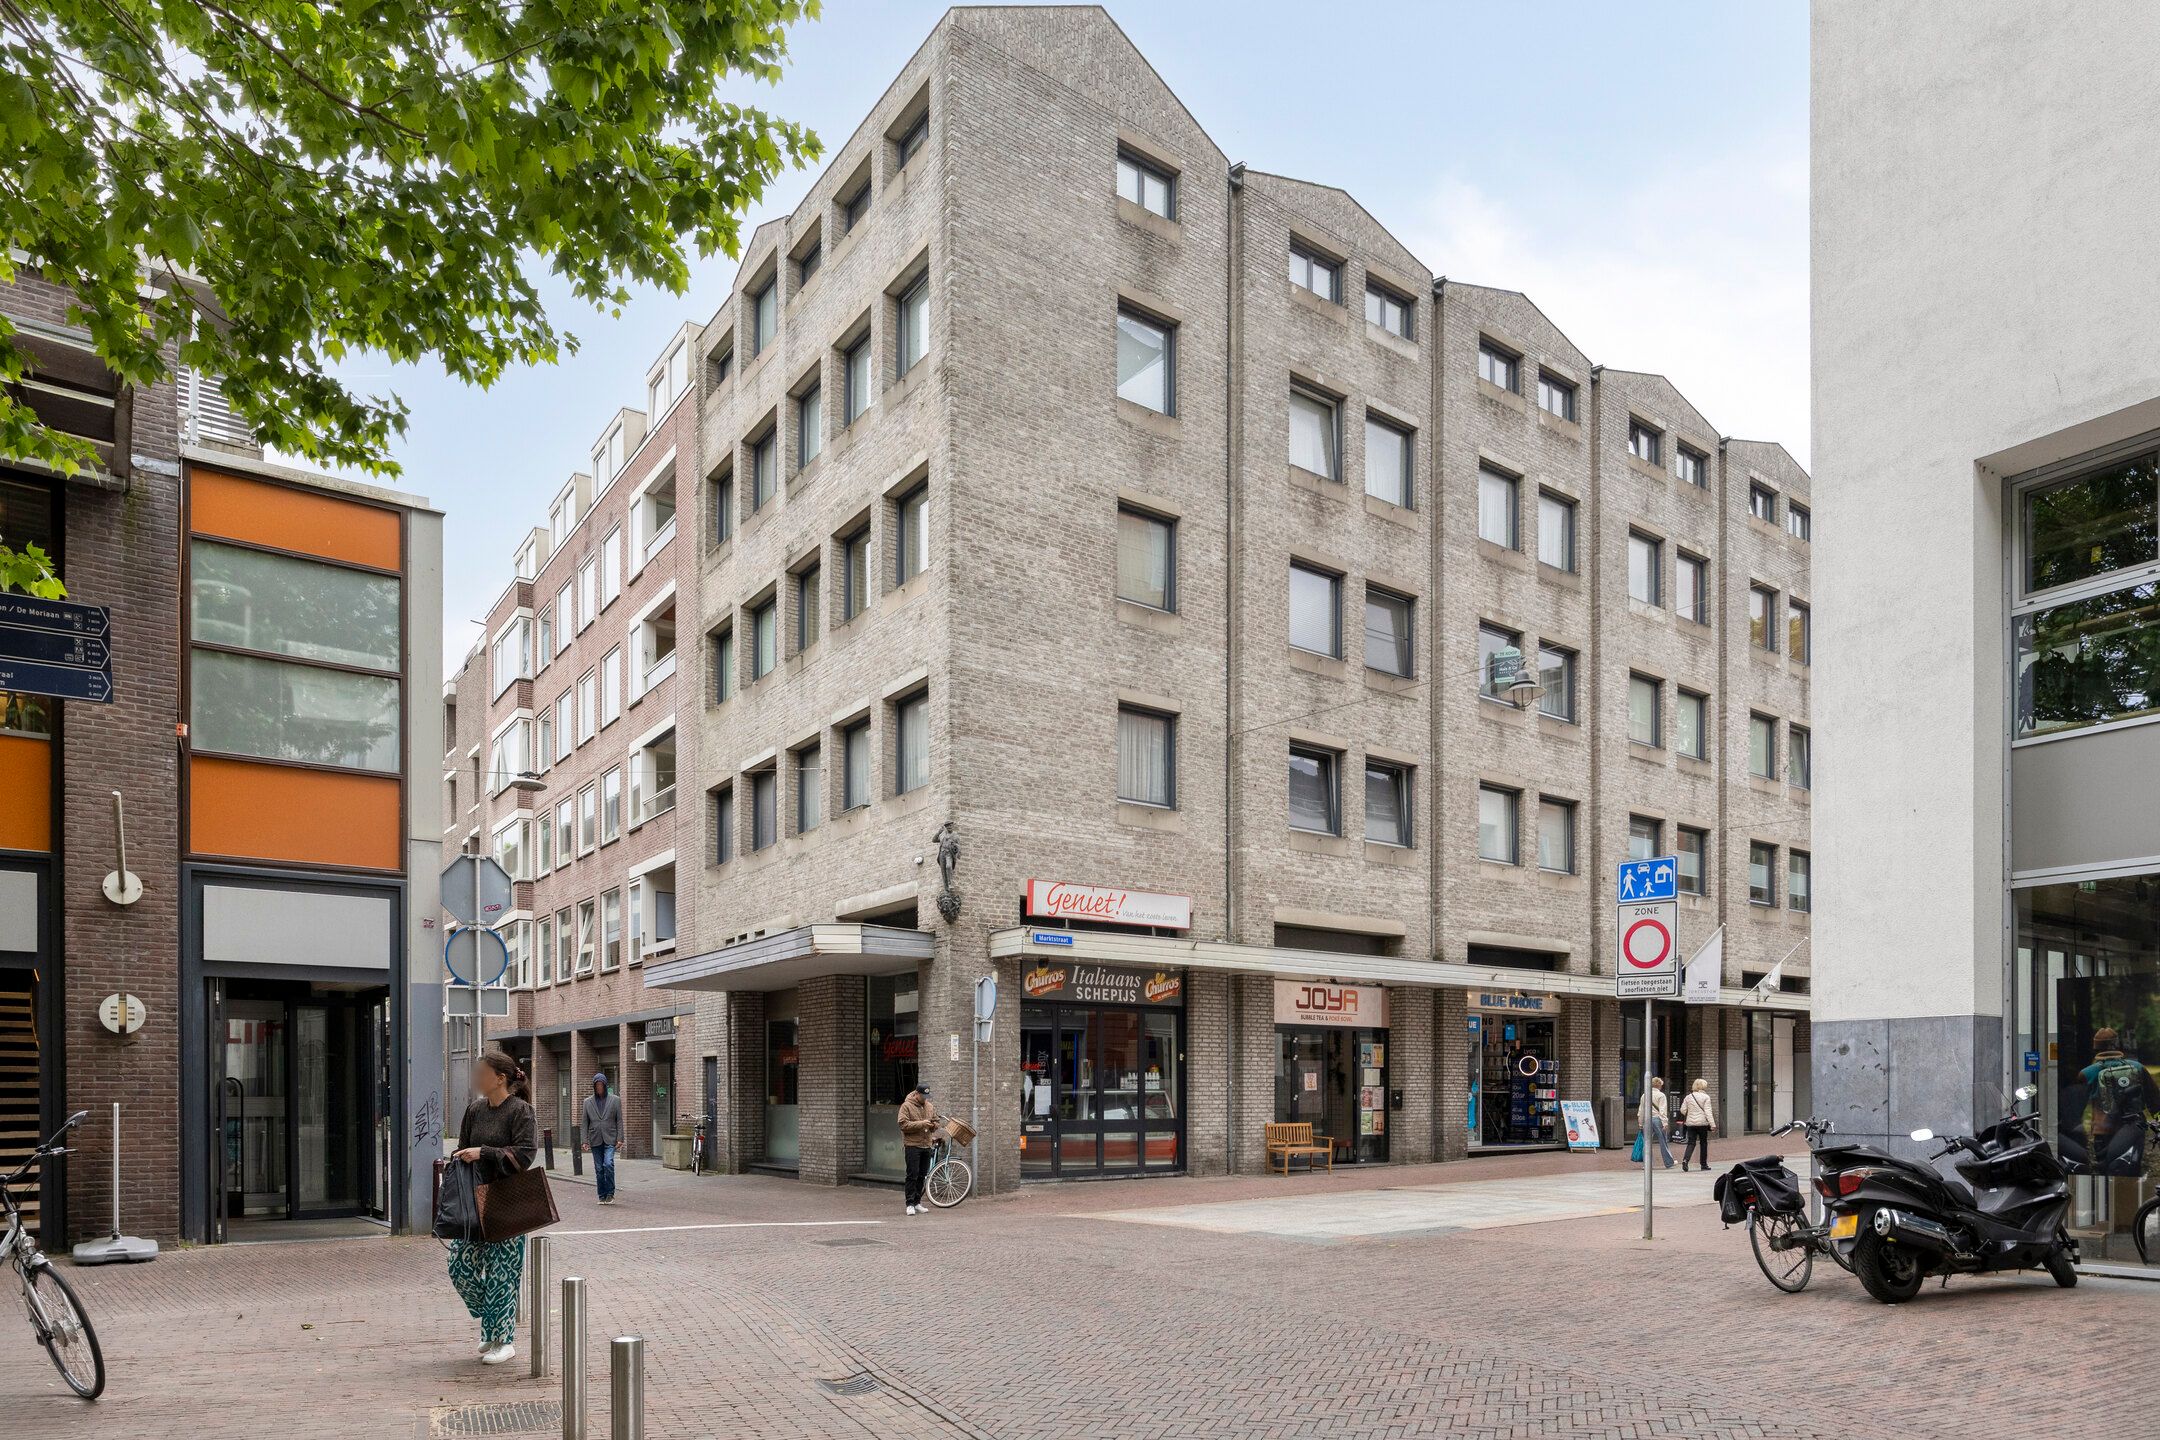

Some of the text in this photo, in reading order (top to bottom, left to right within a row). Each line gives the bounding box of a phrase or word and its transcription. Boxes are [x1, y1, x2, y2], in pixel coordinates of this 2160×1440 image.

[16, 606, 27, 614] De
[29, 608, 60, 619] Moriaan
[1047, 882, 1127, 917] Geniet!
[1634, 906, 1660, 916] ZONE
[1038, 934, 1069, 944] Marktstraat
[1024, 969, 1066, 993] Churros
[1071, 966, 1141, 988] Italiaans
[1641, 978, 1673, 987] toegestaan
[1076, 986, 1137, 1003] SCHEPIJS
[1144, 977, 1181, 1000] Churros
[1624, 985, 1669, 994] snorfietsen niet
[1295, 986, 1359, 1012] JOYA
[1480, 993, 1543, 1010] BLUE PHONE
